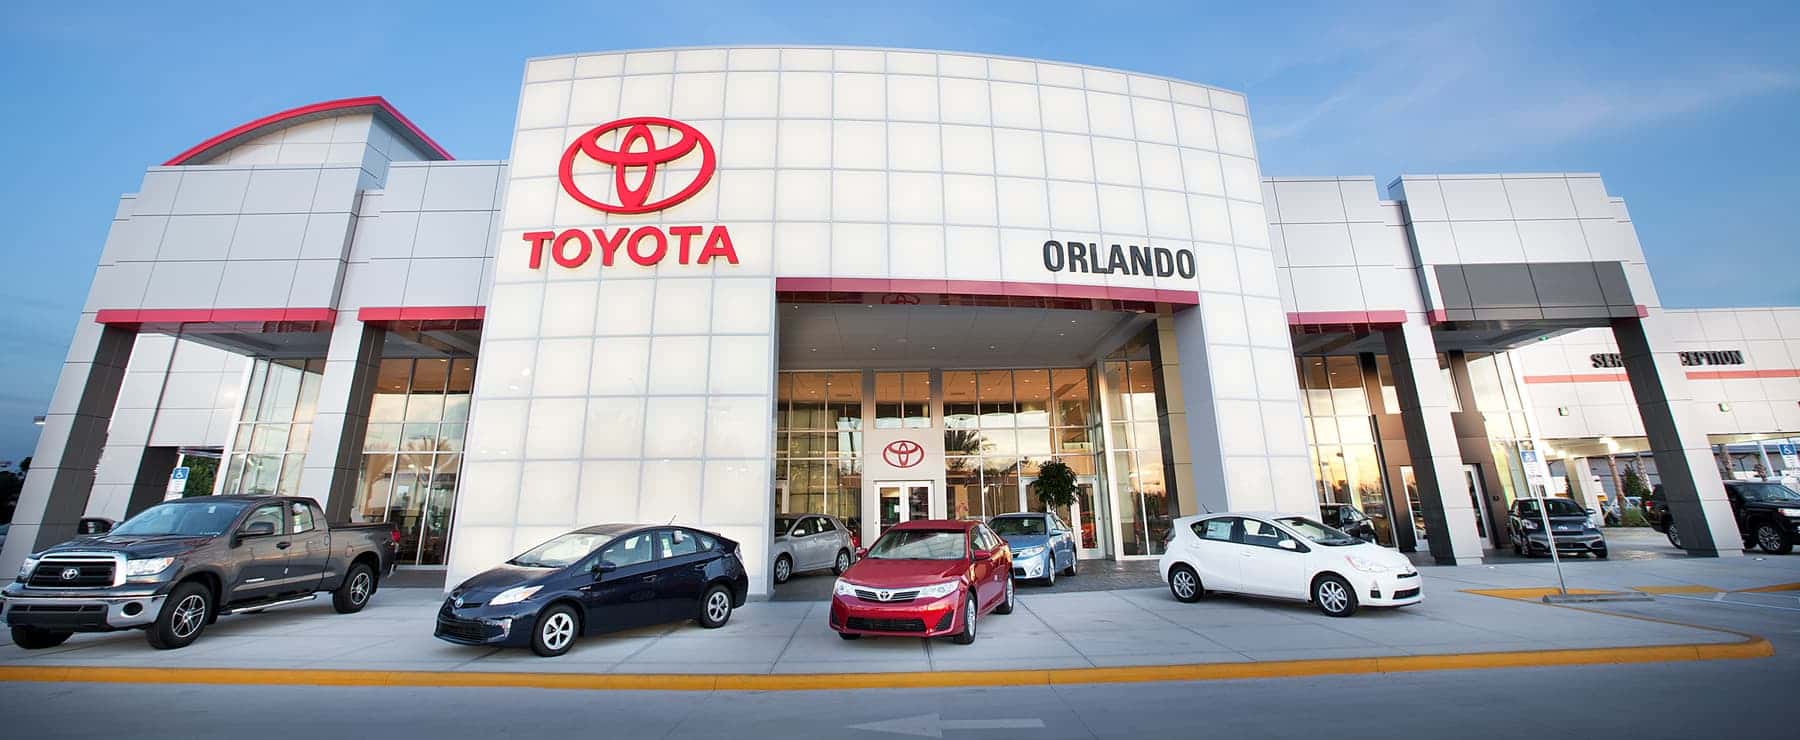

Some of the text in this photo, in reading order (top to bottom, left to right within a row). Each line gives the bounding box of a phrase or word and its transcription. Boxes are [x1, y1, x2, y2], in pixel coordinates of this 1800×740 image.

[522, 225, 739, 269] TOYOTA
[1043, 240, 1196, 279] ORLANDO
[1590, 351, 1744, 368] SER CEPTION
